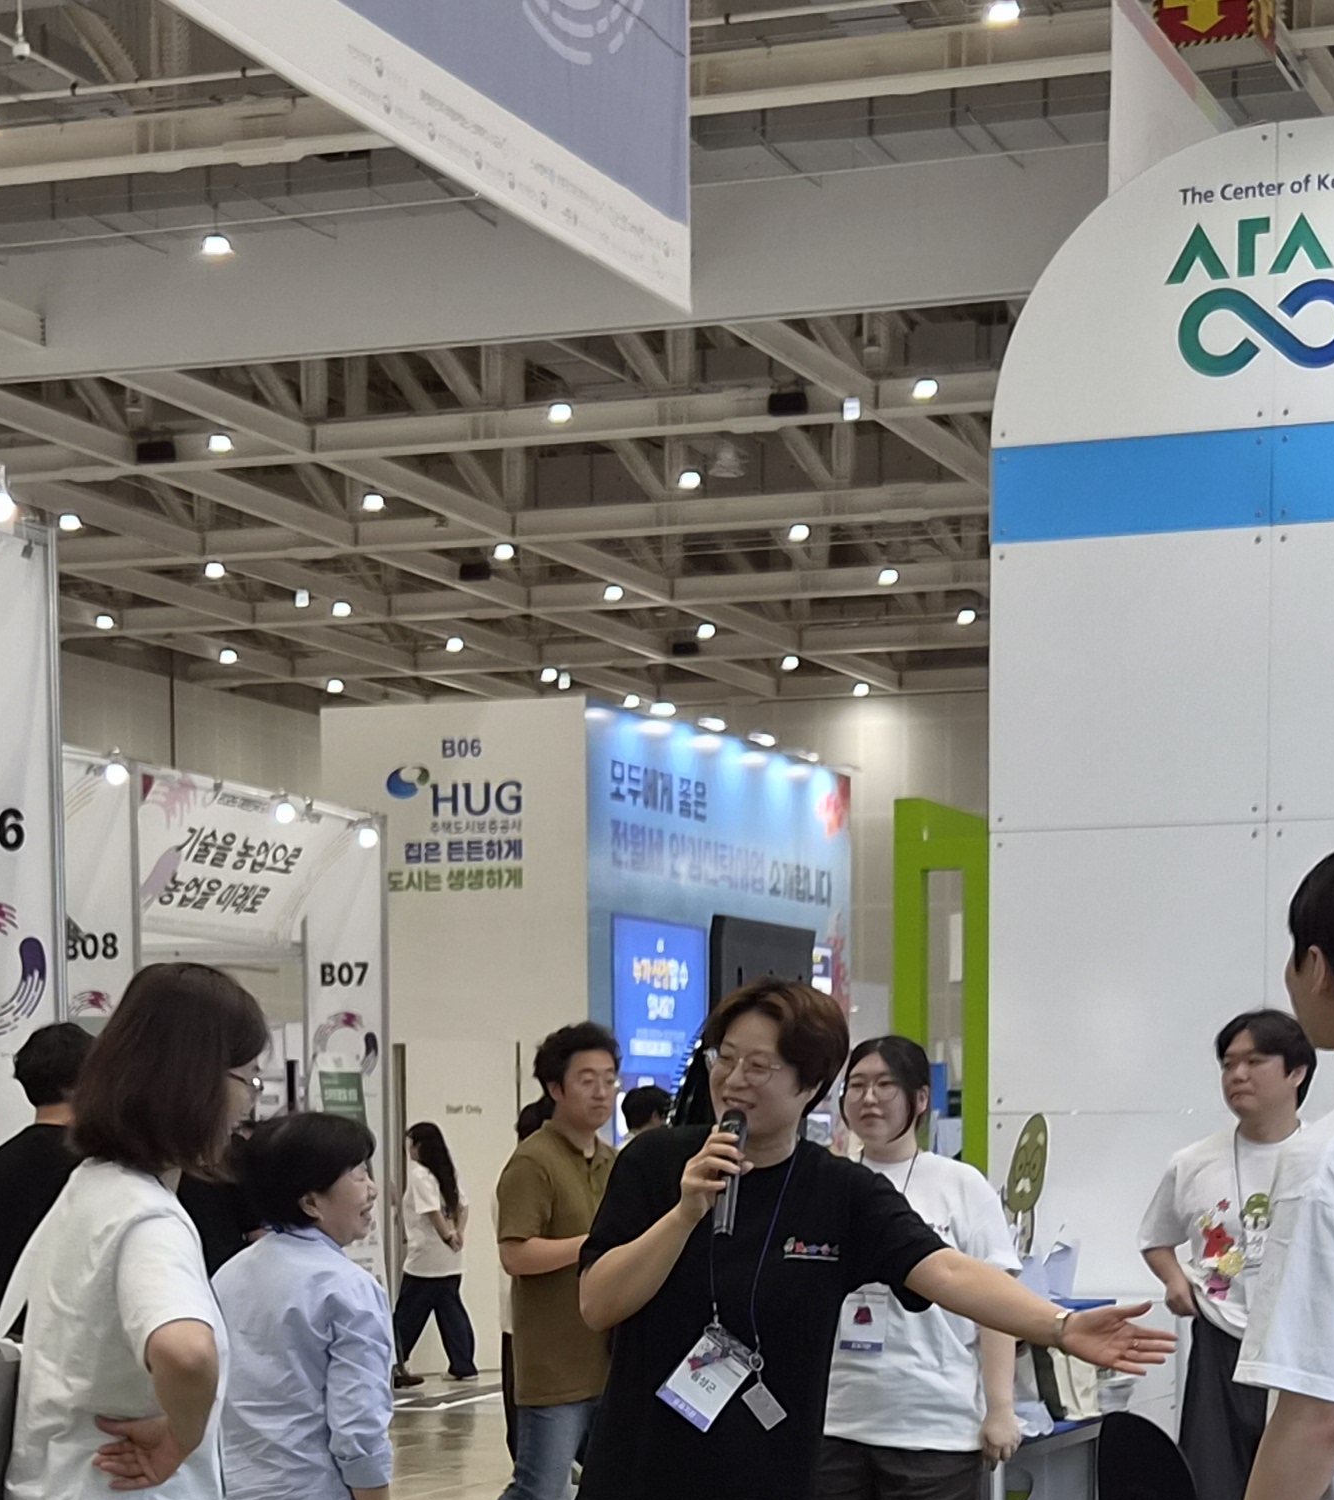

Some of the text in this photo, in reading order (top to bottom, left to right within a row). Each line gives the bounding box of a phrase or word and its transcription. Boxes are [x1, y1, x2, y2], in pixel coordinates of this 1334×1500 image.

[1179, 187, 1215, 206] The
[1220, 180, 1285, 201] Center
[1290, 174, 1312, 195] of
[442, 738, 482, 759] B06
[430, 780, 523, 817] HUG
[678, 776, 708, 823] 좋은
[178, 827, 303, 875] 기술을 농업으로
[404, 839, 523, 864] 집은 든든하게
[158, 873, 271, 915] 농업을 미래로
[388, 866, 524, 892] 도시는 생생하게
[320, 961, 369, 987] B07
